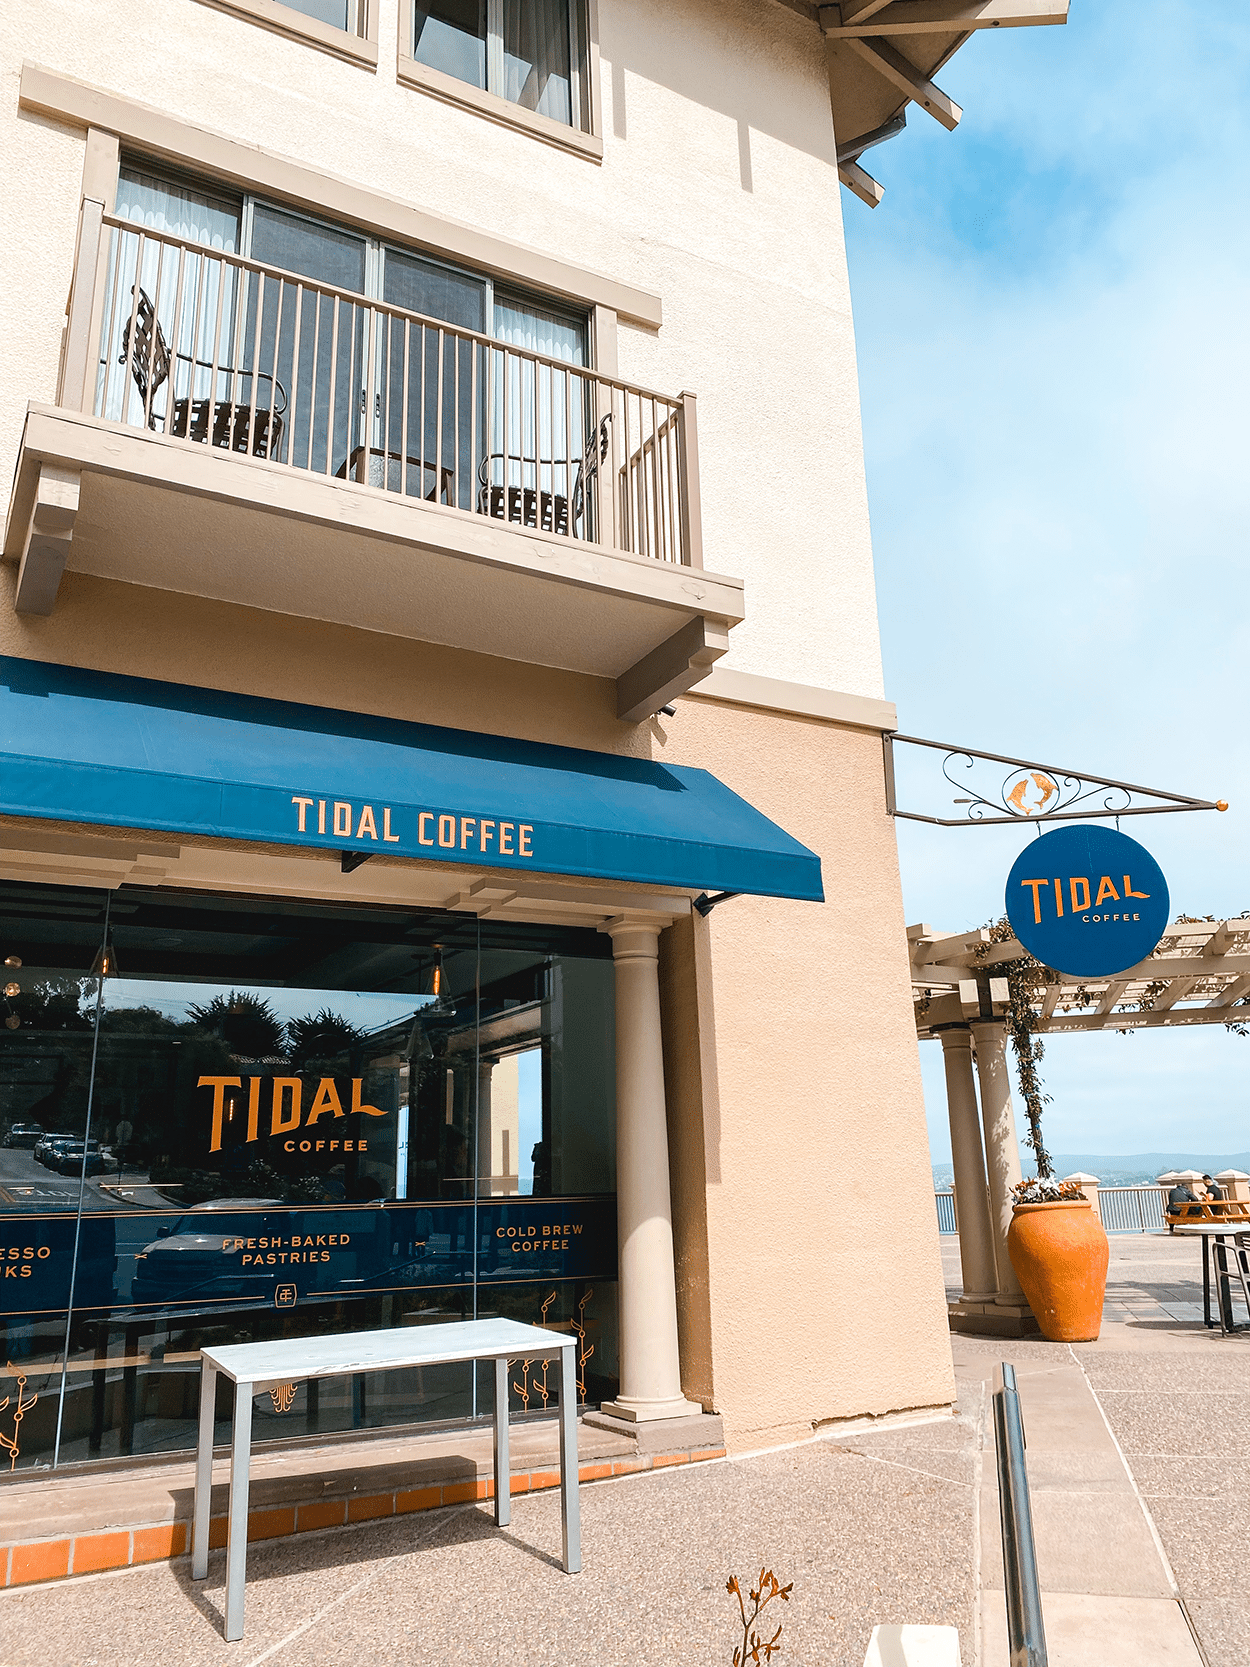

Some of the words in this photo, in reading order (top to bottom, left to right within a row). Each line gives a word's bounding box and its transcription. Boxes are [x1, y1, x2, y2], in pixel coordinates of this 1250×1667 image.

[291, 796, 400, 843] TIDAL
[418, 811, 534, 857] COFFEE
[1021, 874, 1151, 924] TIDAL
[1082, 913, 1141, 923] COFFEE
[197, 1075, 389, 1153] TIDAL
[283, 1140, 368, 1152] COFFEE
[496, 1226, 537, 1238] COLD
[542, 1224, 584, 1236] BREW
[222, 1233, 351, 1250] FRESH-BAKED
[511, 1239, 569, 1252] COFFEE
[242, 1250, 331, 1266] PASTRIES
[0, 1264, 32, 1278] KS
